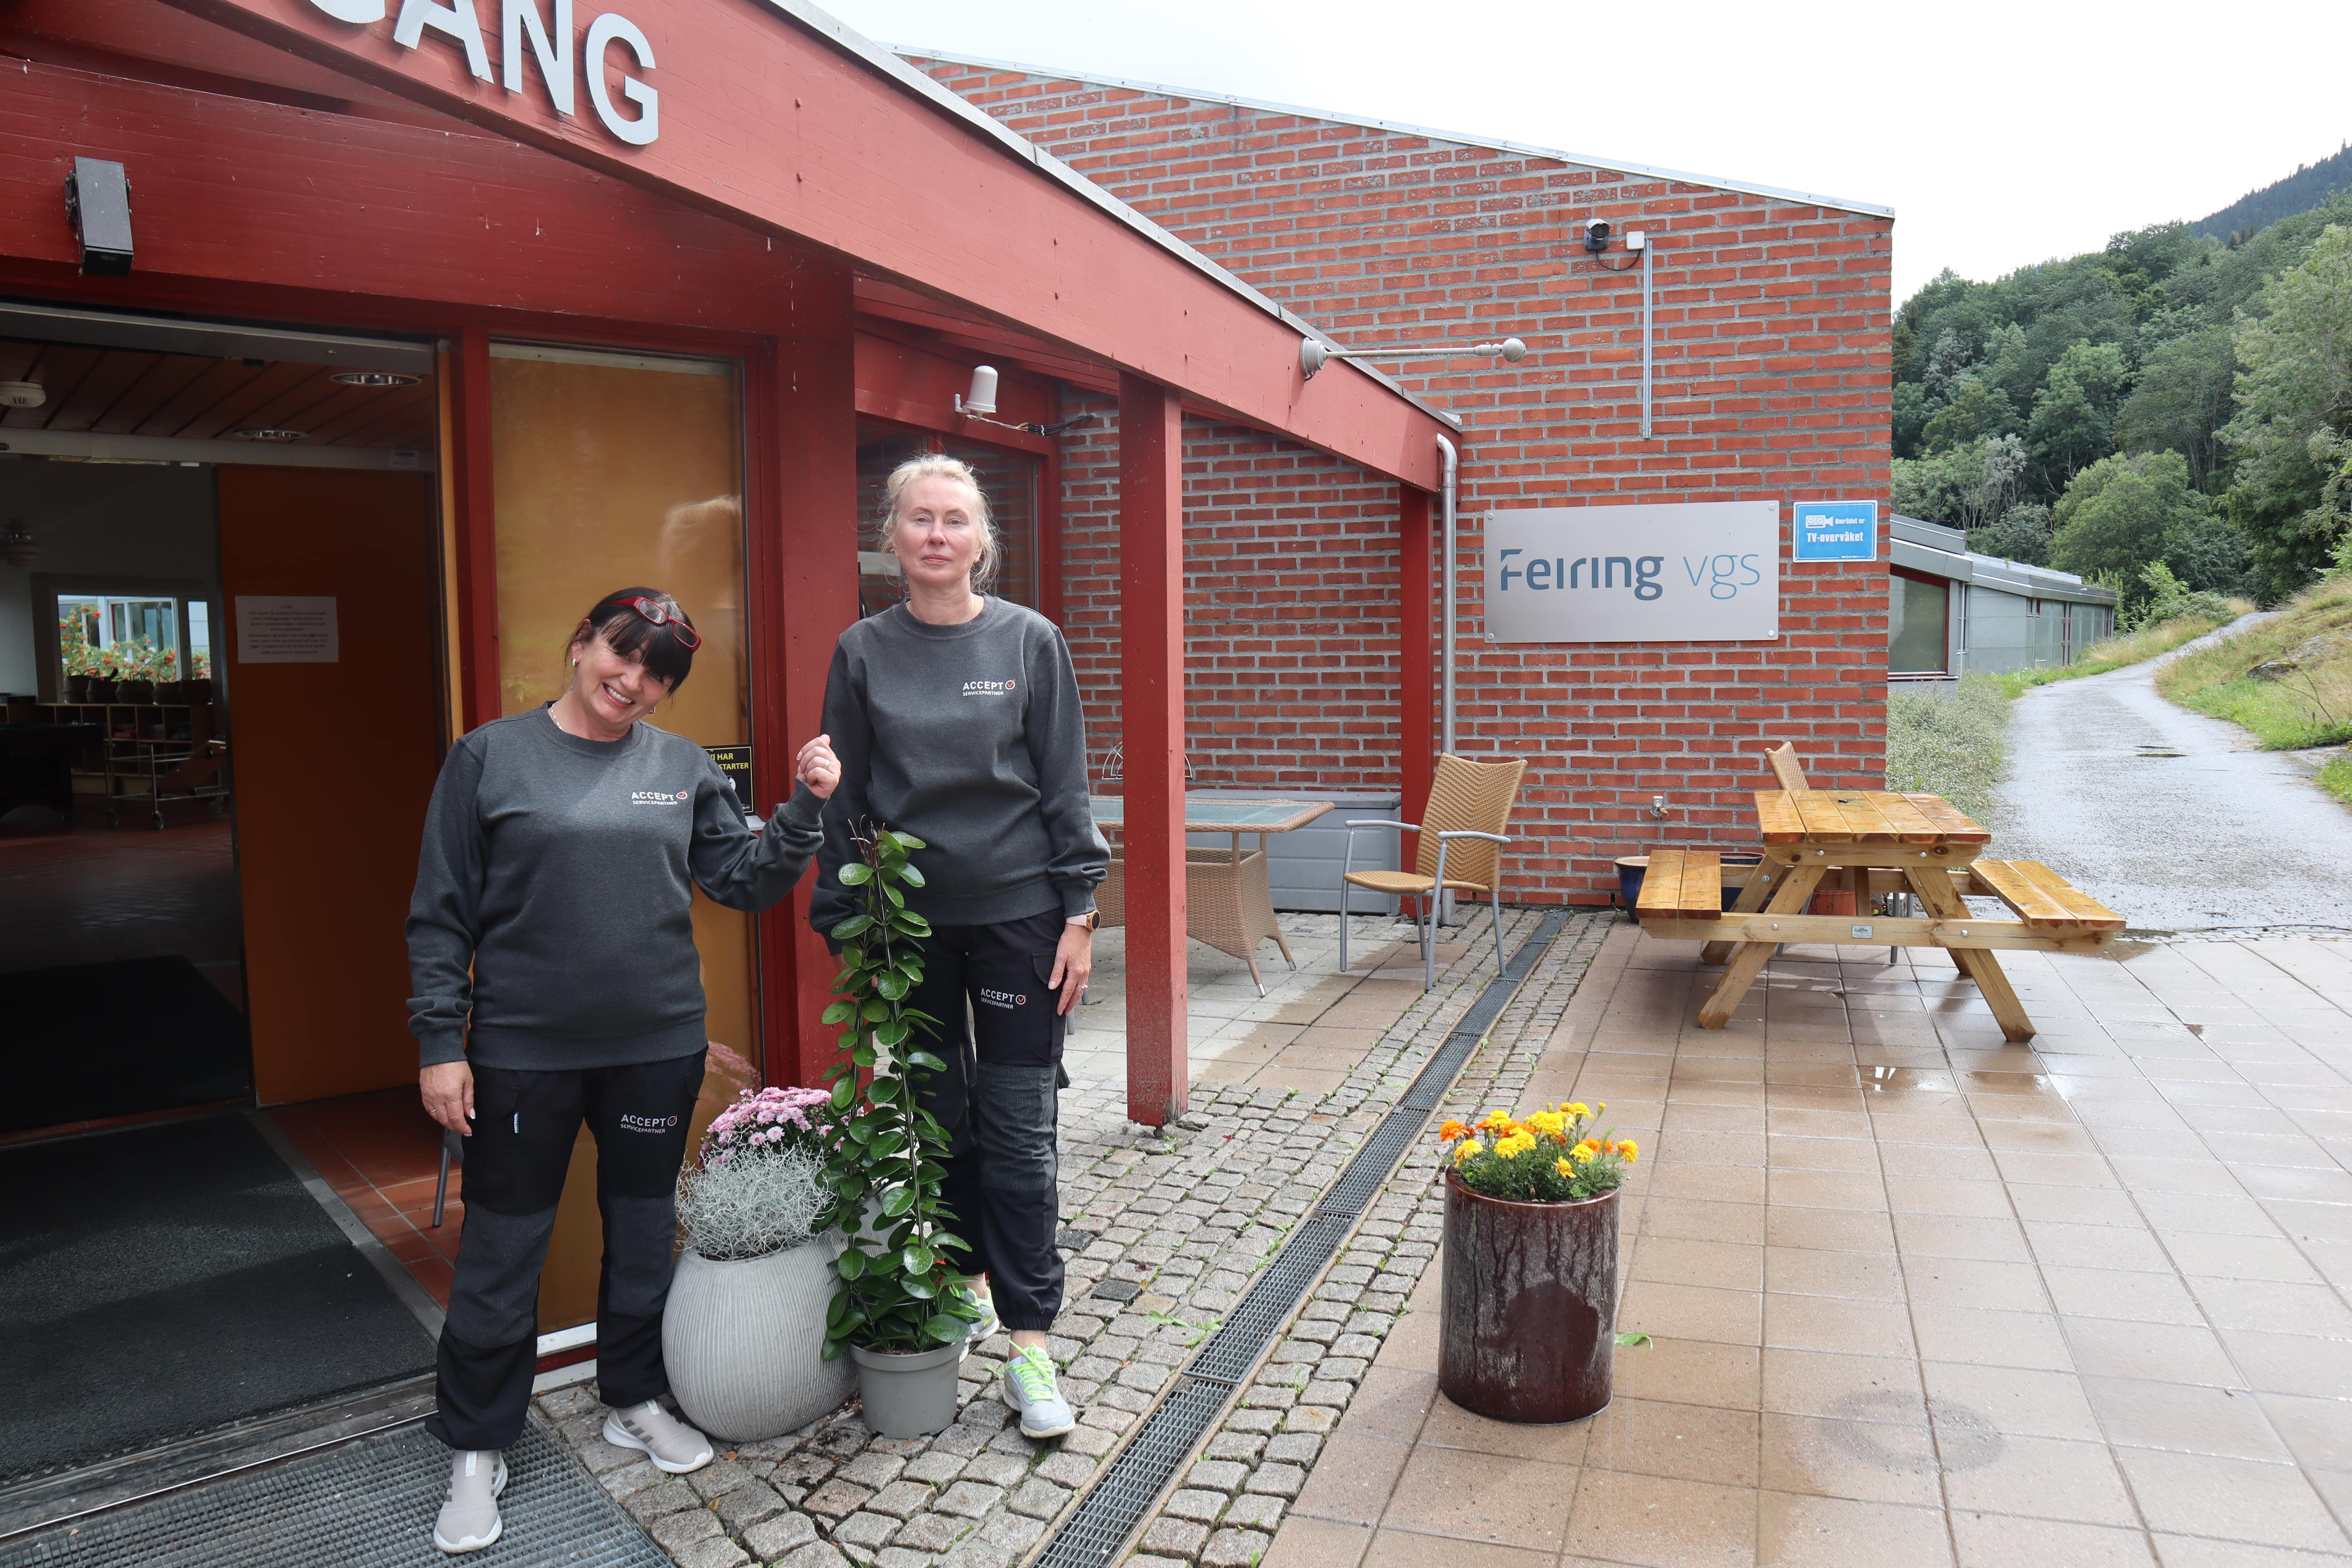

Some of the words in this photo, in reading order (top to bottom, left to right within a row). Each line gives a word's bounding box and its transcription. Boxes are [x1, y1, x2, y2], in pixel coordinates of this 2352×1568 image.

[308, 0, 659, 145] ANG
[1807, 532, 1864, 543] TV-overvåket
[1501, 549, 1664, 601] Feiring
[1683, 554, 1760, 600] vgs
[963, 681, 1004, 690] ACCEPT
[632, 792, 674, 801] ACCEPT
[981, 988, 1014, 1002] ACCEPT
[981, 997, 1013, 1009] SERVICEPARTNER
[621, 1114, 666, 1127] ACCEPT
[621, 1123, 665, 1134] SERVICEPARTNER
